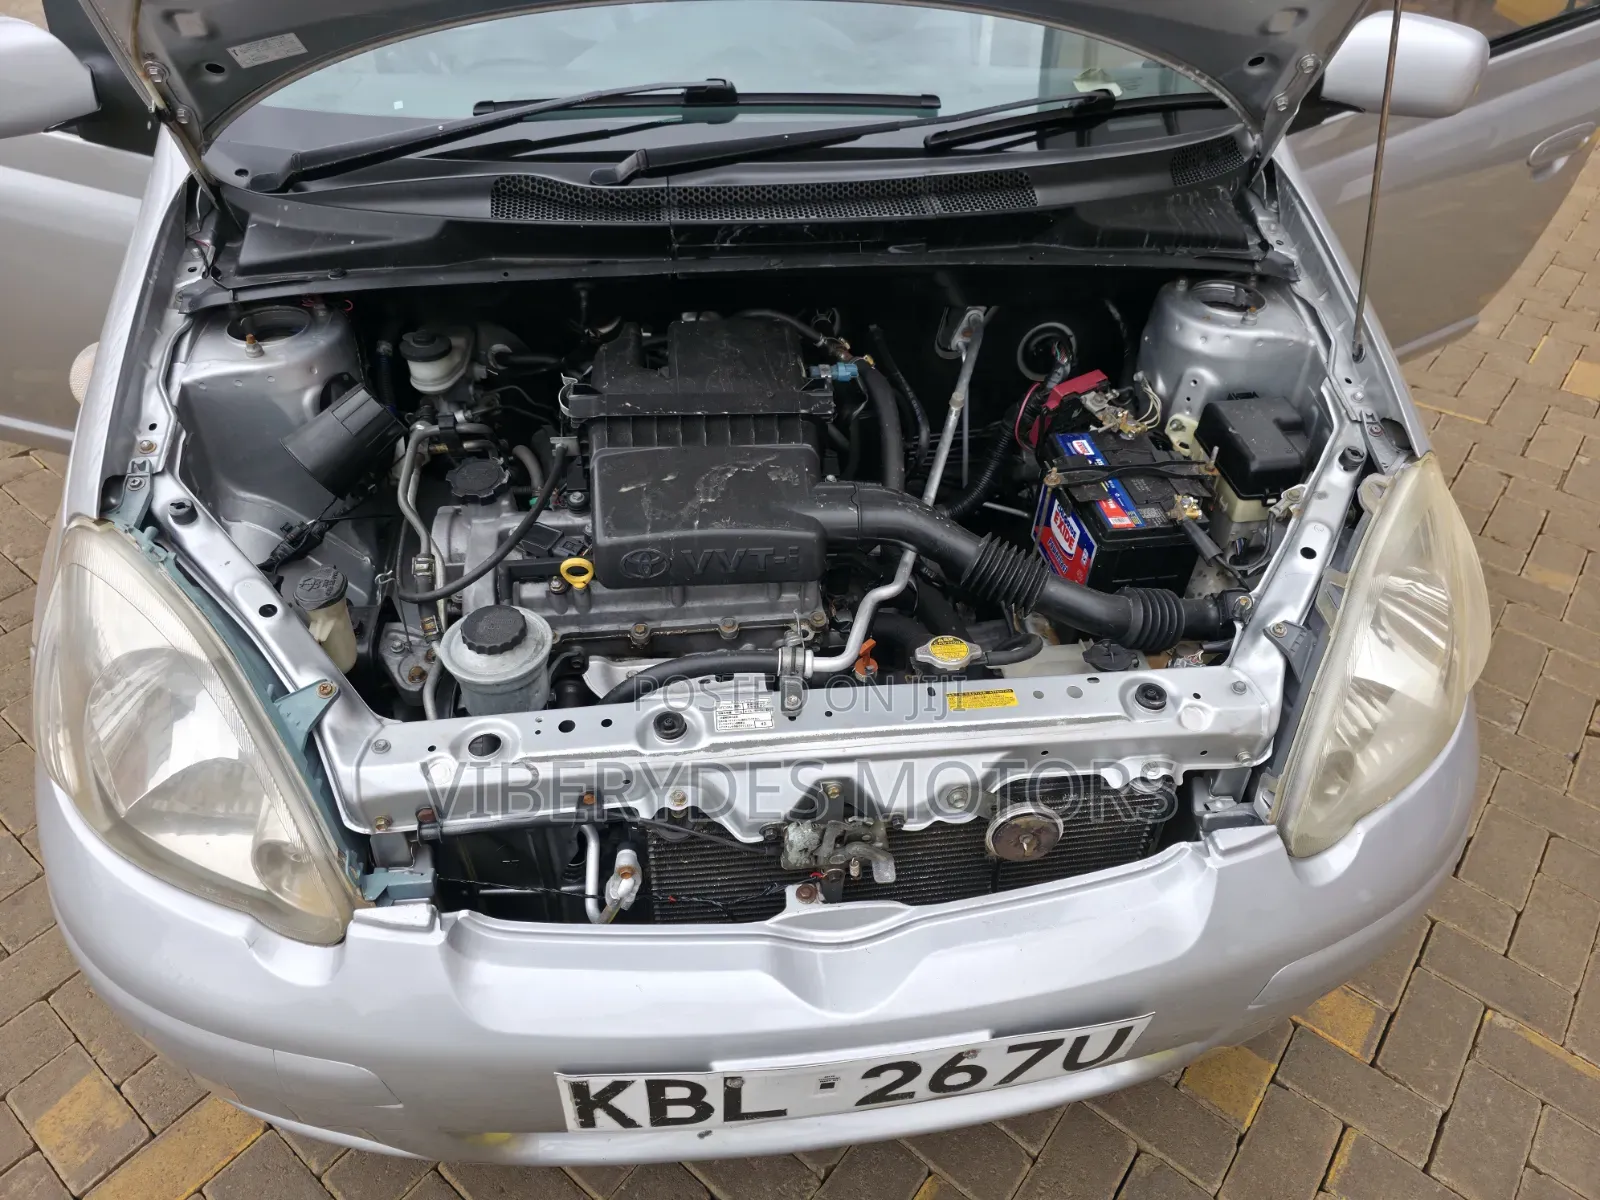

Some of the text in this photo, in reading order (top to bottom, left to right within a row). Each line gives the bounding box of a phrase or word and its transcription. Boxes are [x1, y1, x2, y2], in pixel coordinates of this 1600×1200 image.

[1053, 510, 1076, 550] EXIDE
[681, 546, 799, 574] VVT-i
[569, 1026, 1134, 1129] KBL 267U
